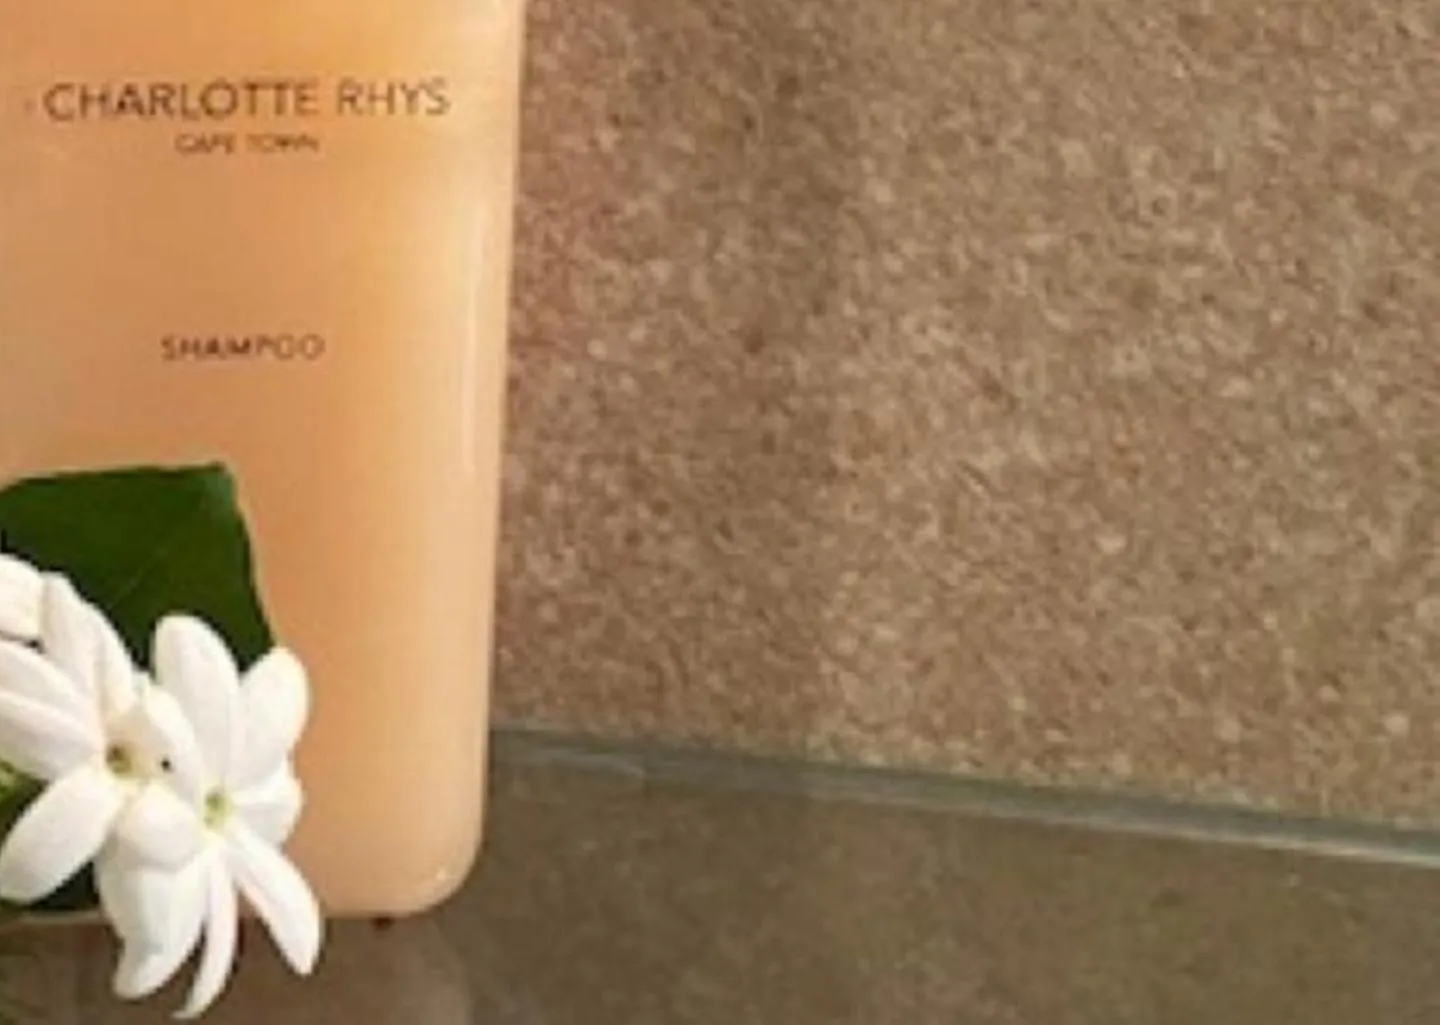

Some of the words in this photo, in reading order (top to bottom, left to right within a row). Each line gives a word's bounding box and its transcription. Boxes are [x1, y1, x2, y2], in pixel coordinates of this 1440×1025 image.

[43, 78, 320, 122] CHARLOTTE
[337, 78, 451, 118] RHYS
[173, 132, 236, 155] CAPE
[245, 132, 322, 155] TOWN
[160, 332, 327, 362] SHAMPOO
